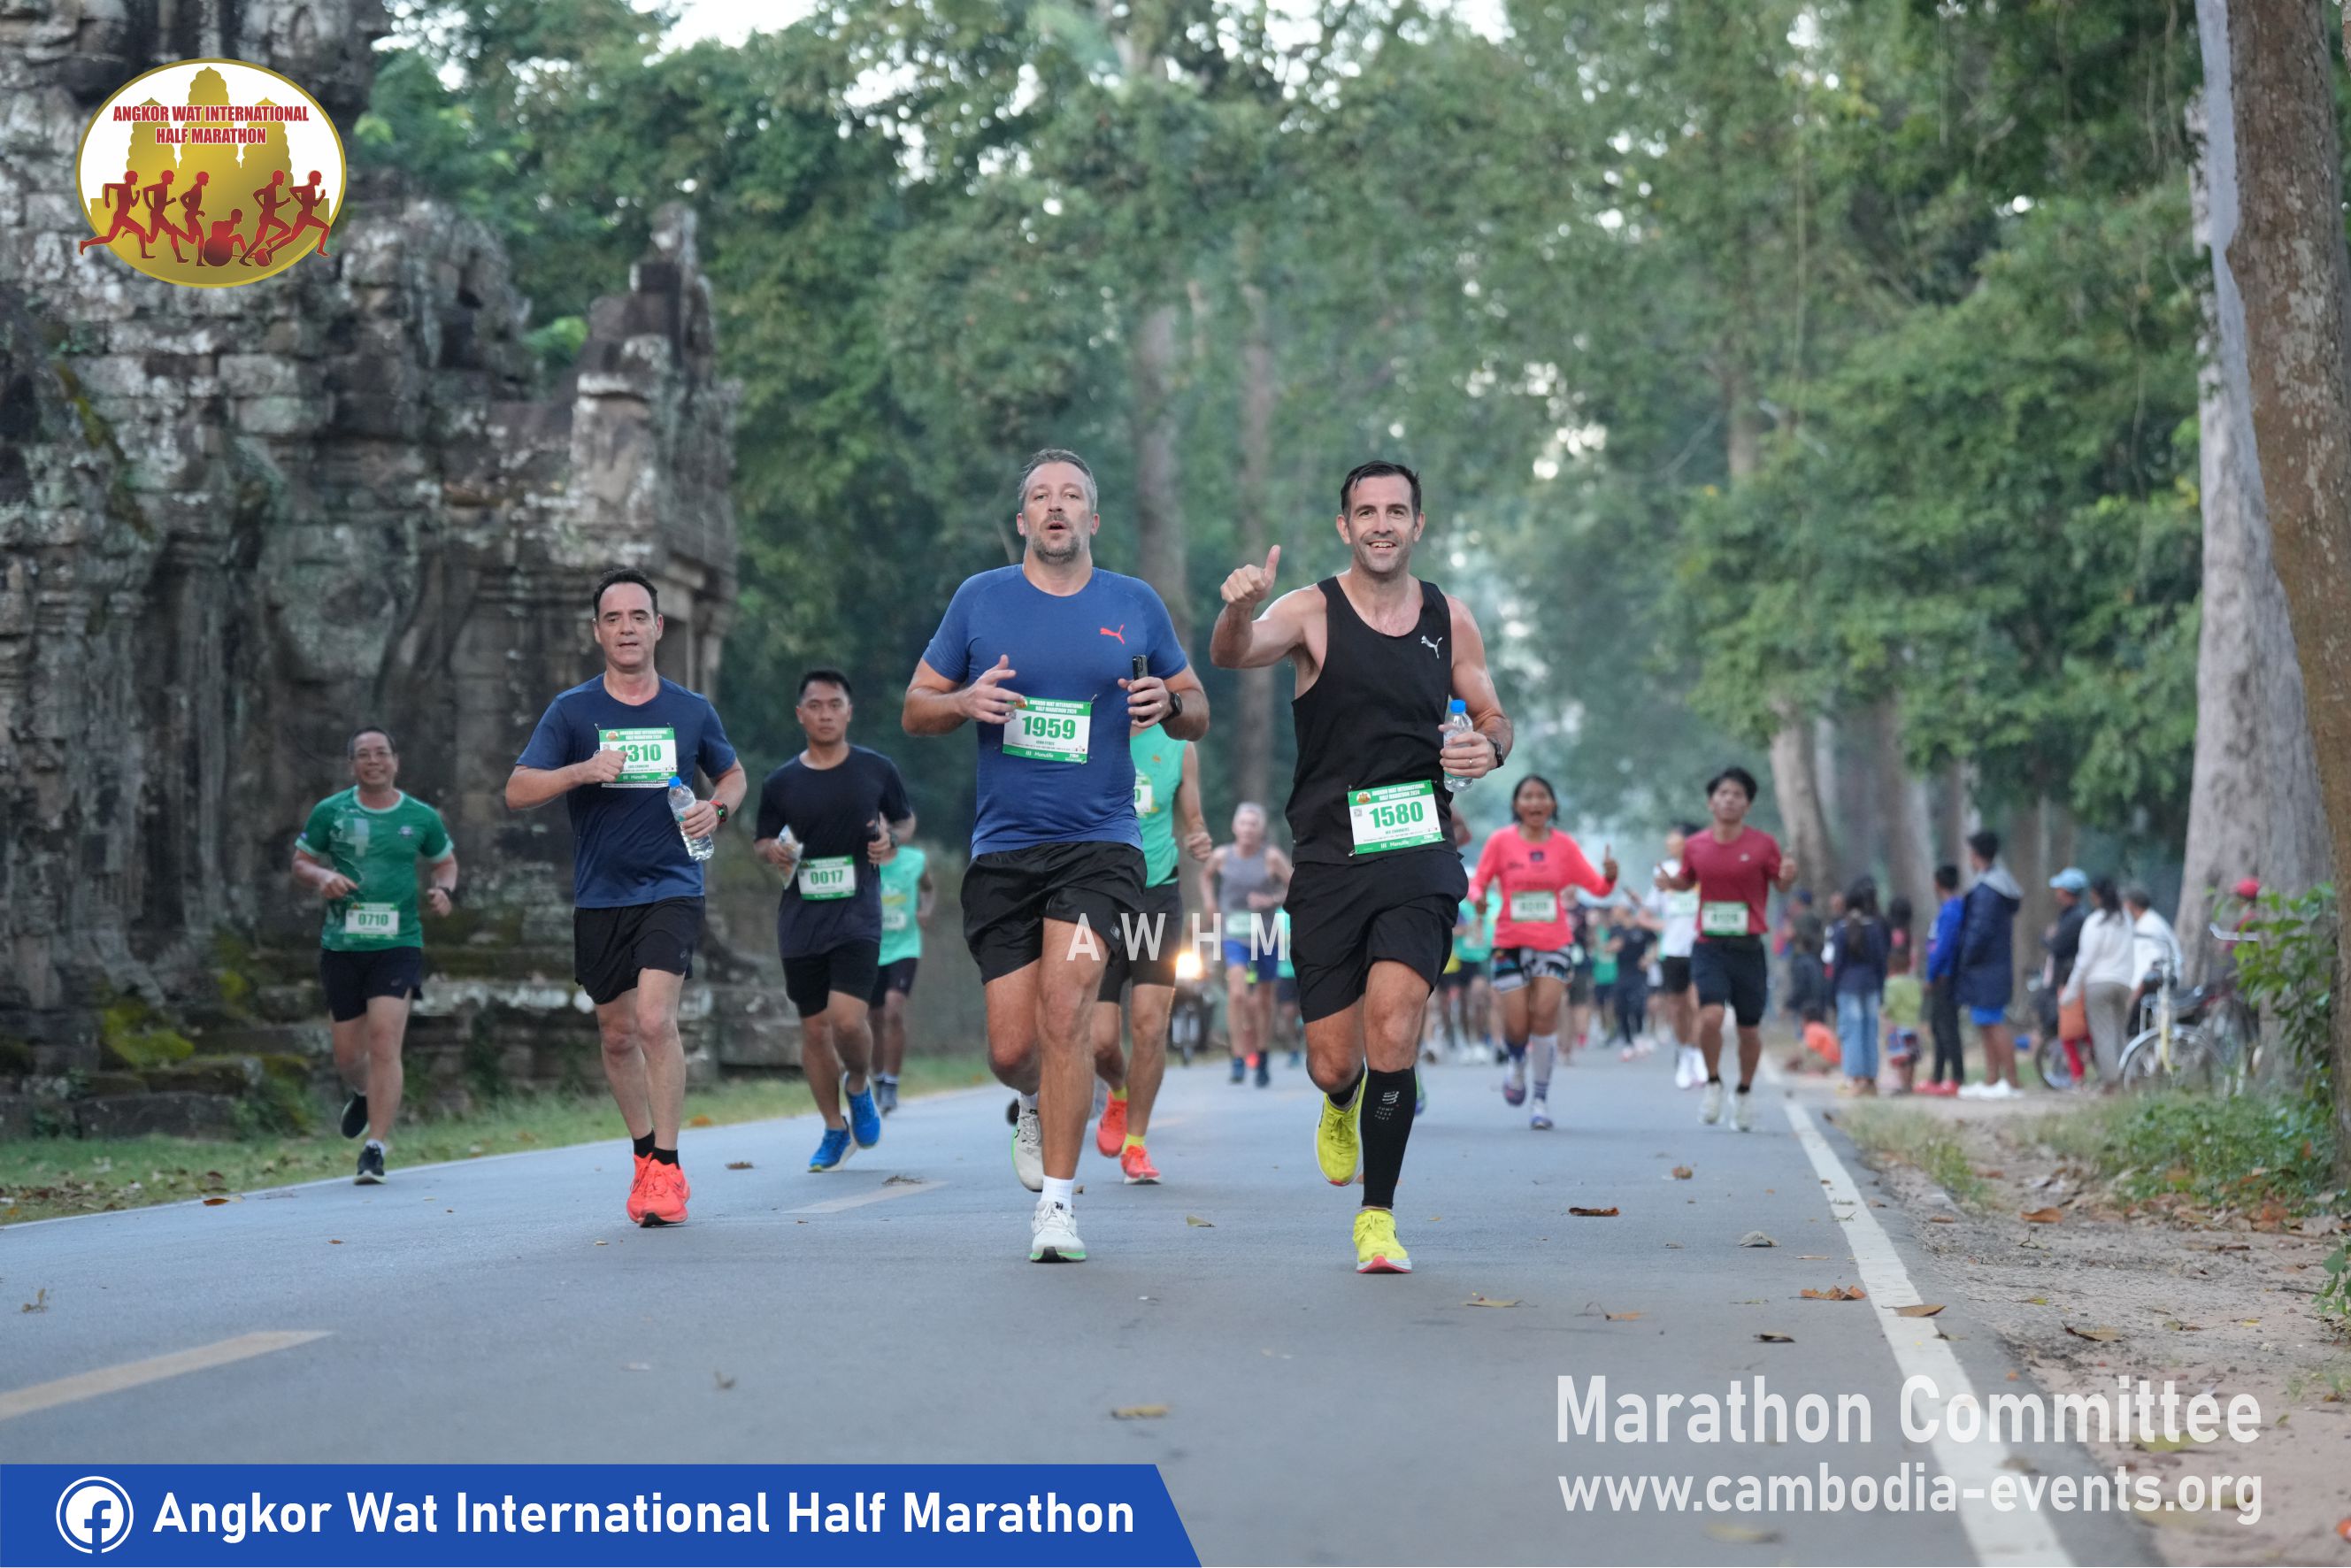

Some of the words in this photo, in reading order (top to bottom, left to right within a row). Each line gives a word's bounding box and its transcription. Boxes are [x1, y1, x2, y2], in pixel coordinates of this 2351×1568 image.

[1022, 716, 1076, 740] 1959
[1369, 802, 1424, 828] 1580
[811, 869, 843, 885] 0017
[358, 913, 388, 926] 0710
